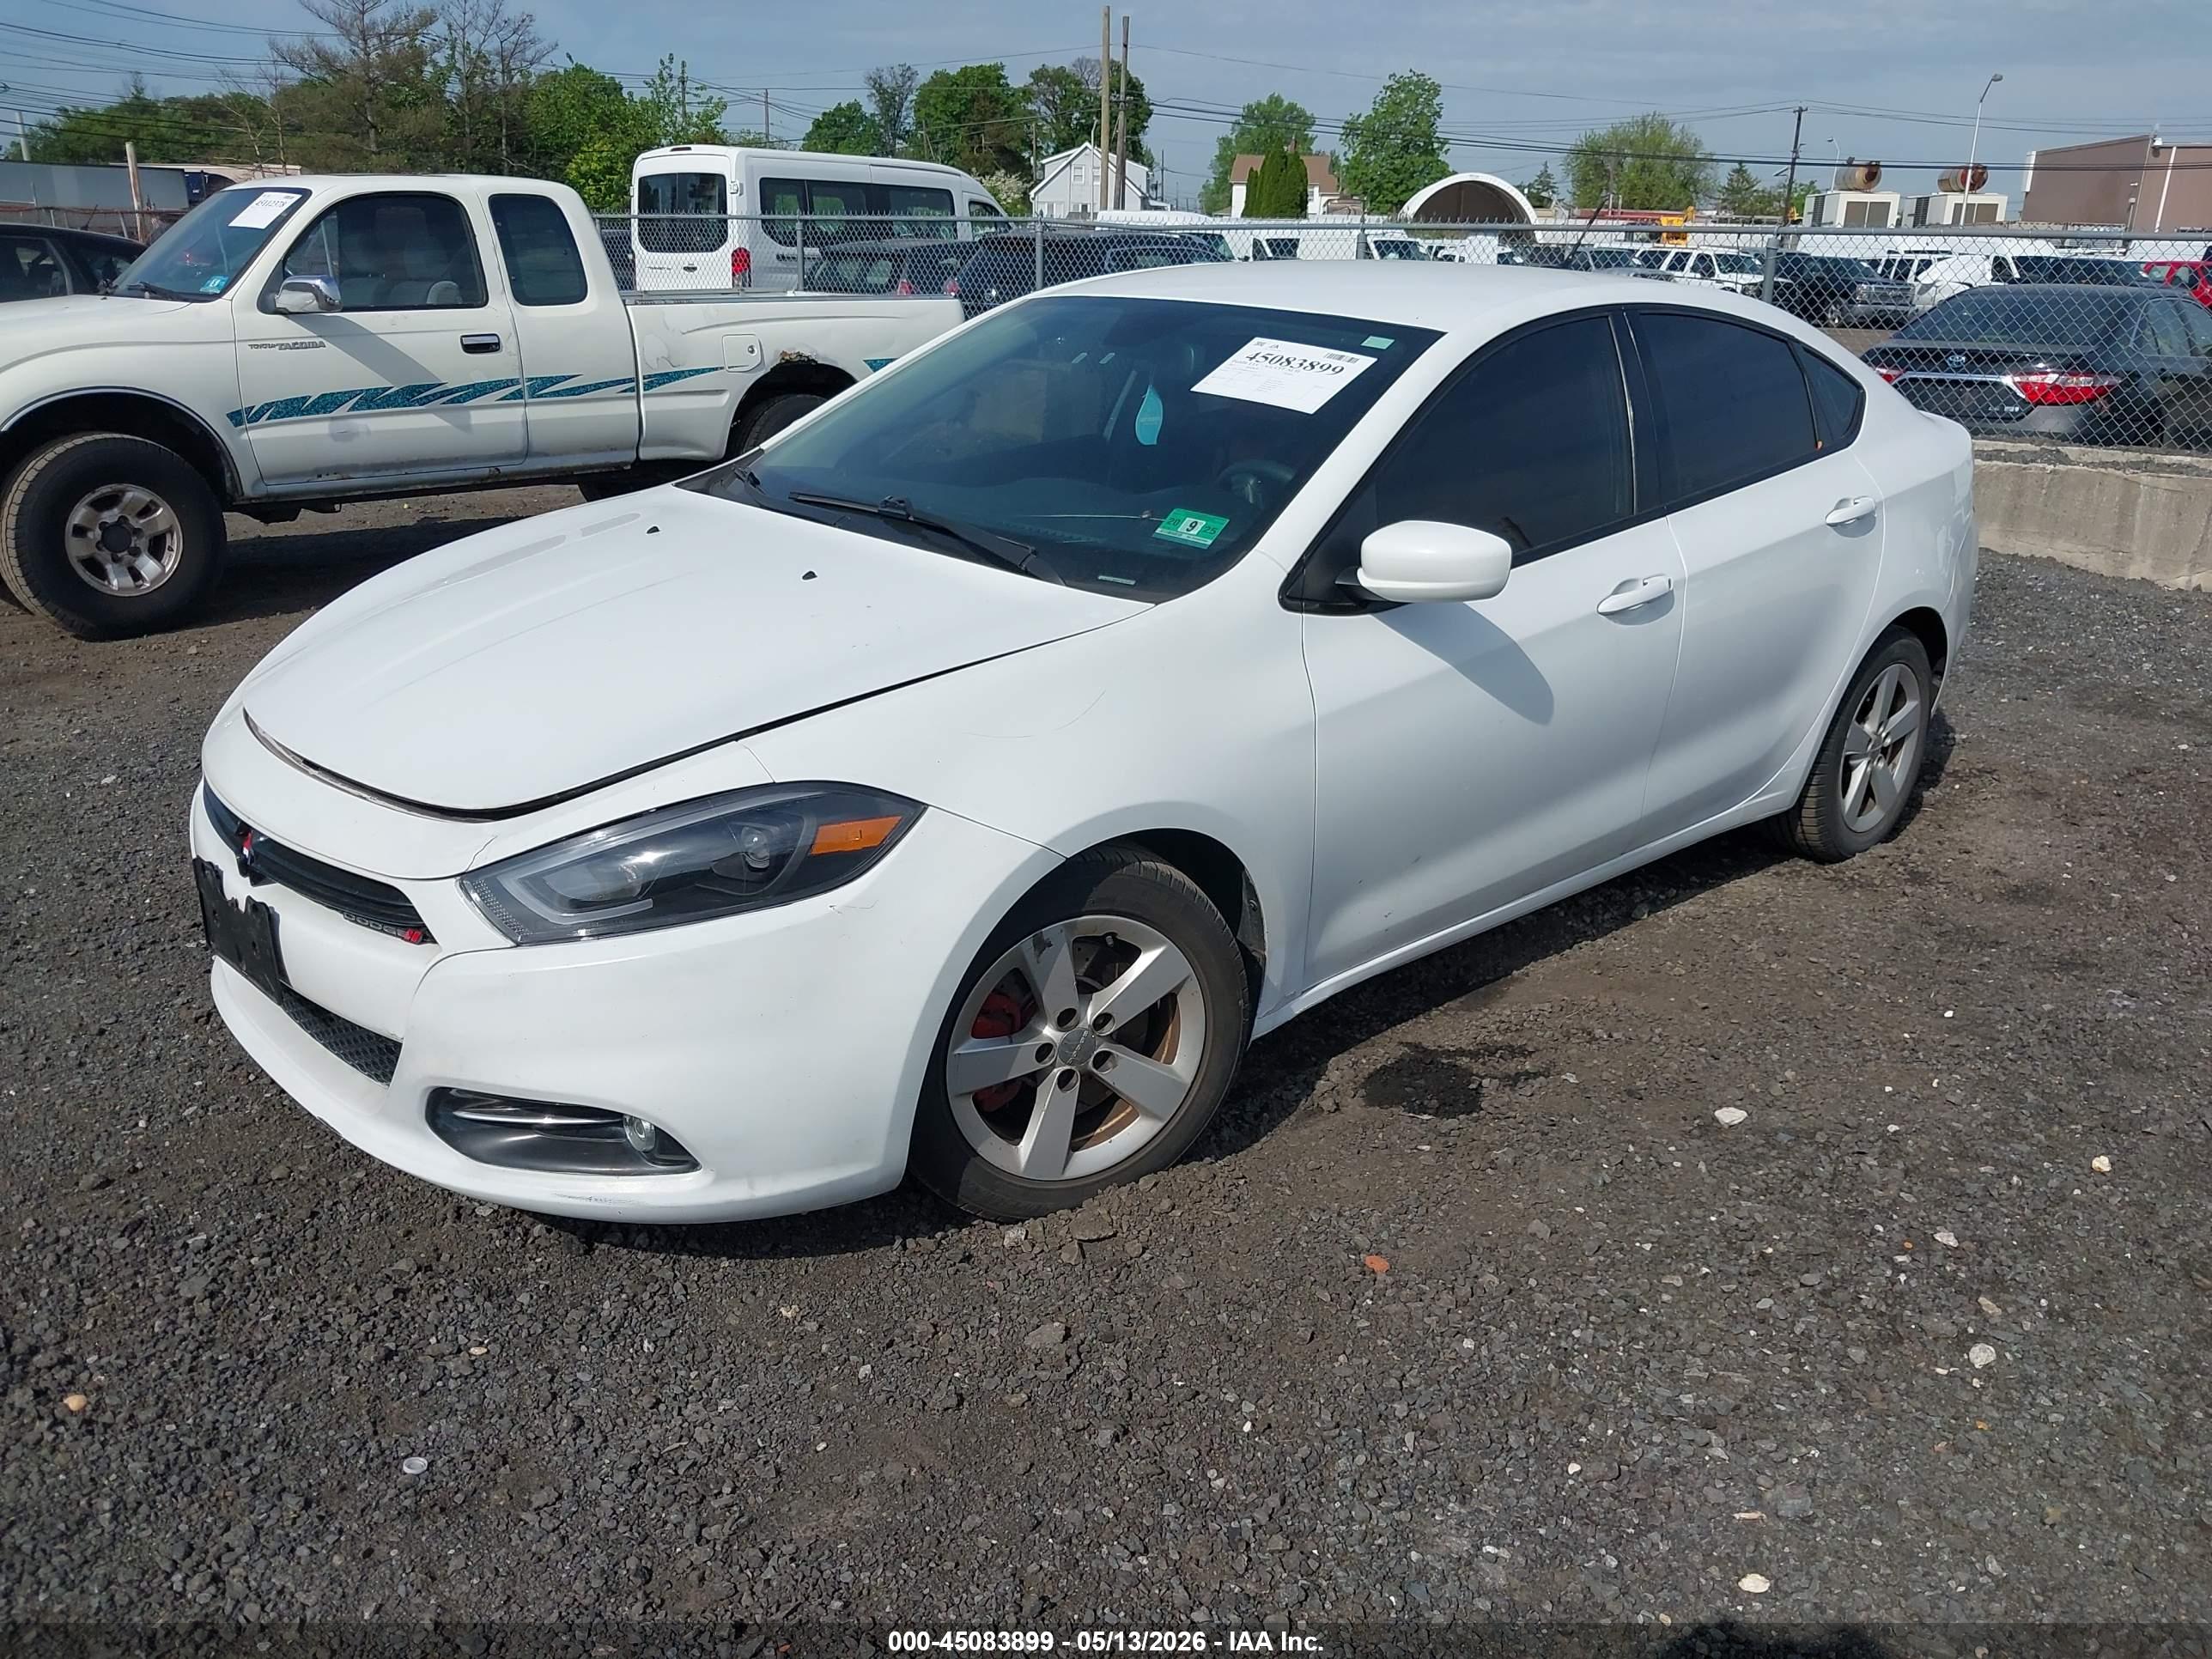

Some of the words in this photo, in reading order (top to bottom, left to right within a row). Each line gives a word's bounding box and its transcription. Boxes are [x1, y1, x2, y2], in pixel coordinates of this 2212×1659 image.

[276, 341, 326, 351] TACOMA
[1245, 351, 1345, 375] 45083899
[1168, 517, 1182, 526] 20
[1186, 520, 1198, 532] 9
[1203, 526, 1217, 535] 25
[343, 912, 408, 939] DODGE
